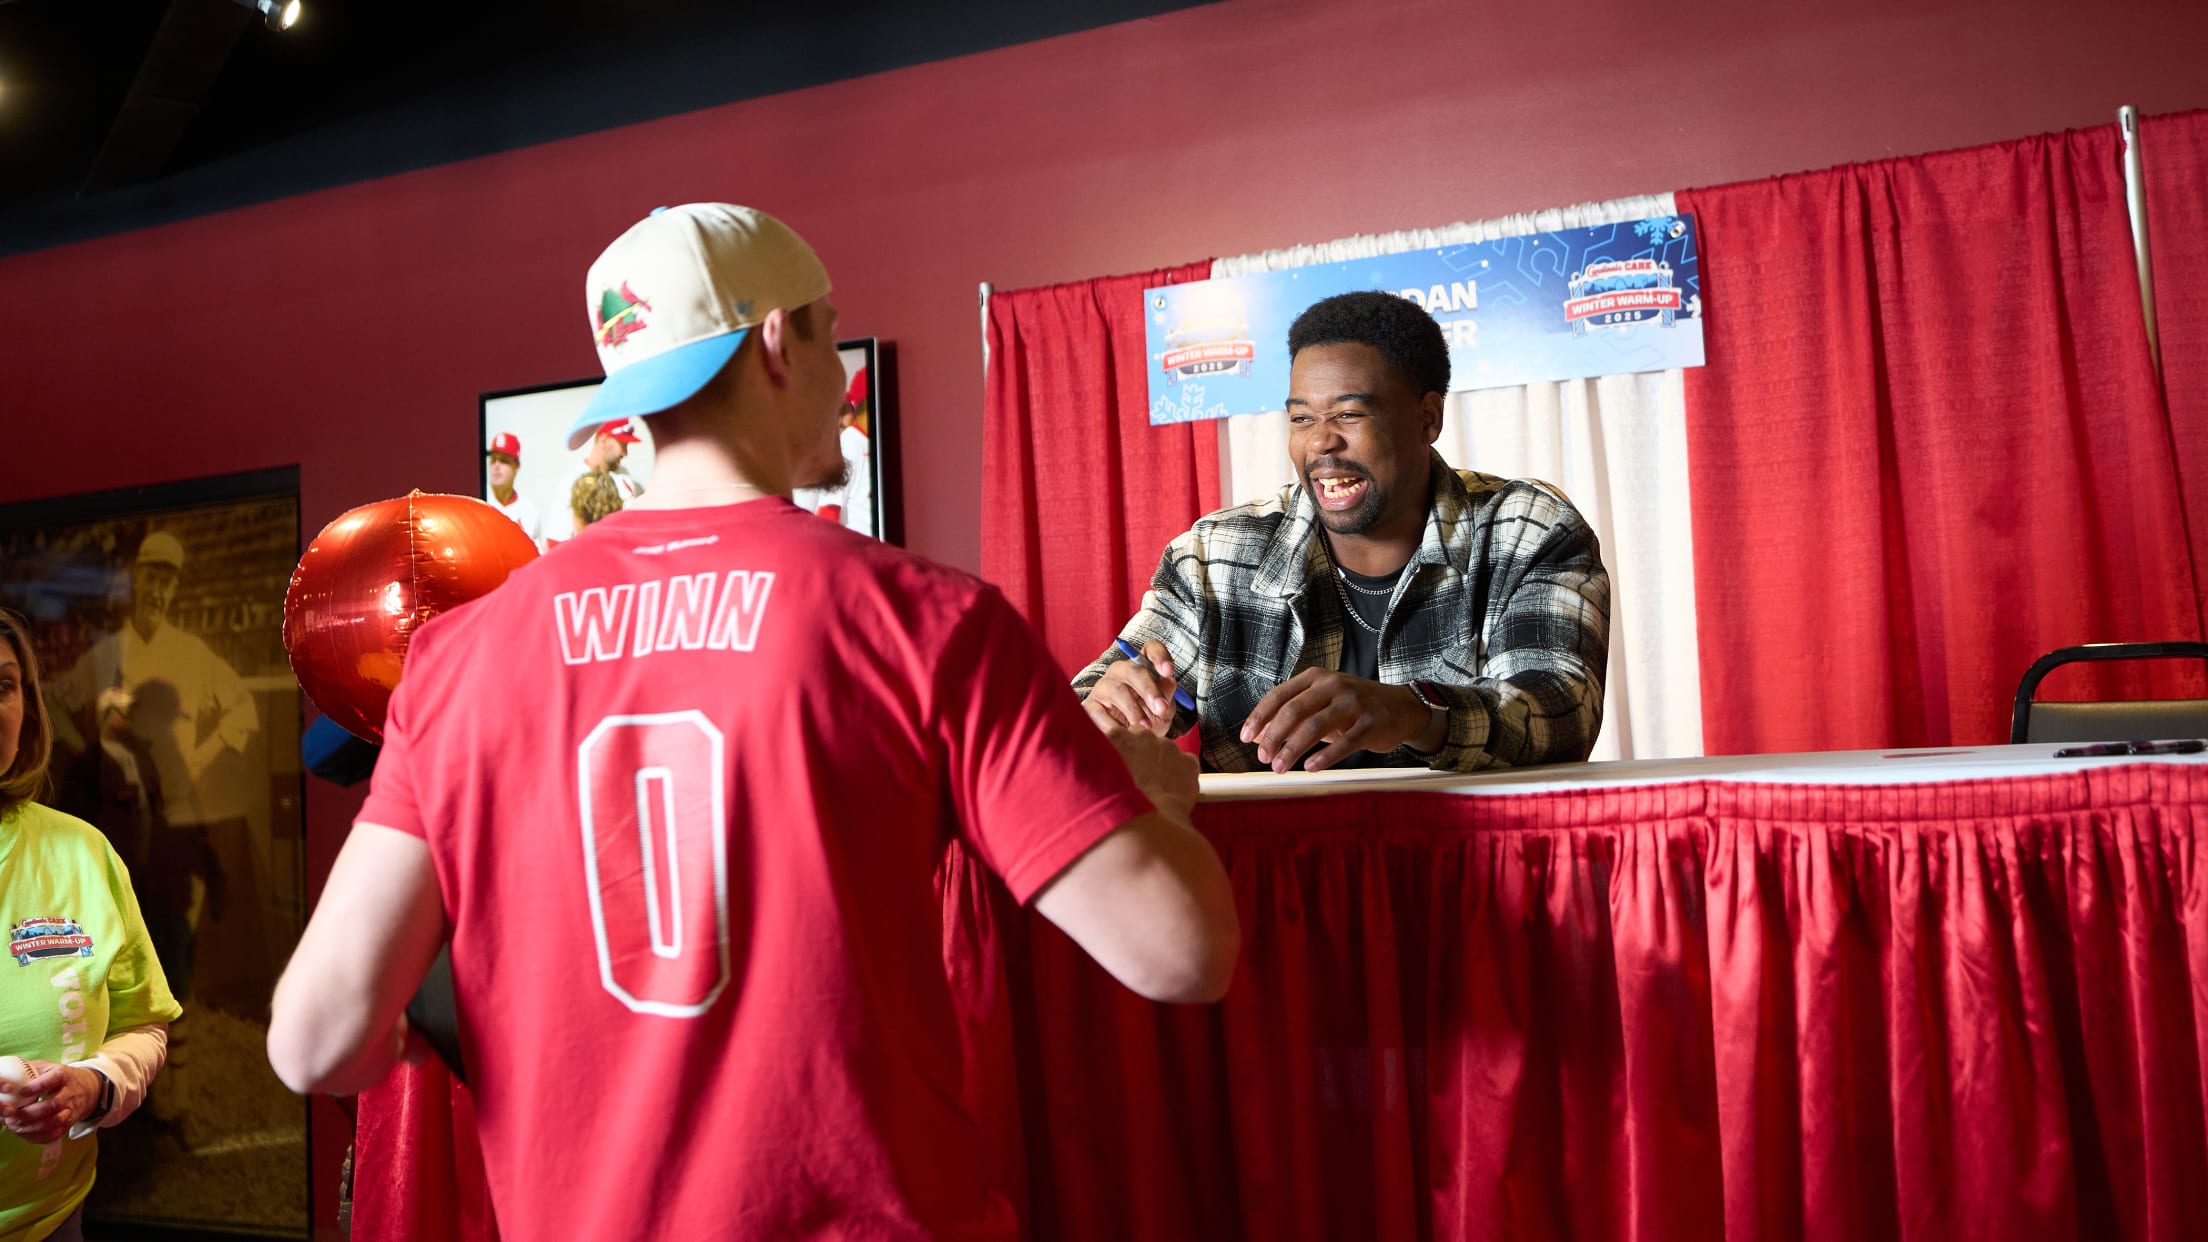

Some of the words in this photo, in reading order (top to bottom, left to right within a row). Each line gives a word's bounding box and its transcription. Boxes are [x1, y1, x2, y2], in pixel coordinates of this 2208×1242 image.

[1390, 280, 1477, 313] DAN
[1572, 298, 1615, 315] WINTER
[1617, 294, 1673, 306] WARM-UP
[1605, 310, 1641, 323] 2025
[1167, 349, 1202, 366] WINTER
[1193, 360, 1223, 373] 2025
[554, 570, 776, 665] WINN
[577, 709, 731, 1018] 0
[15, 940, 46, 951] WINTER
[47, 937, 86, 947] WARM-UP
